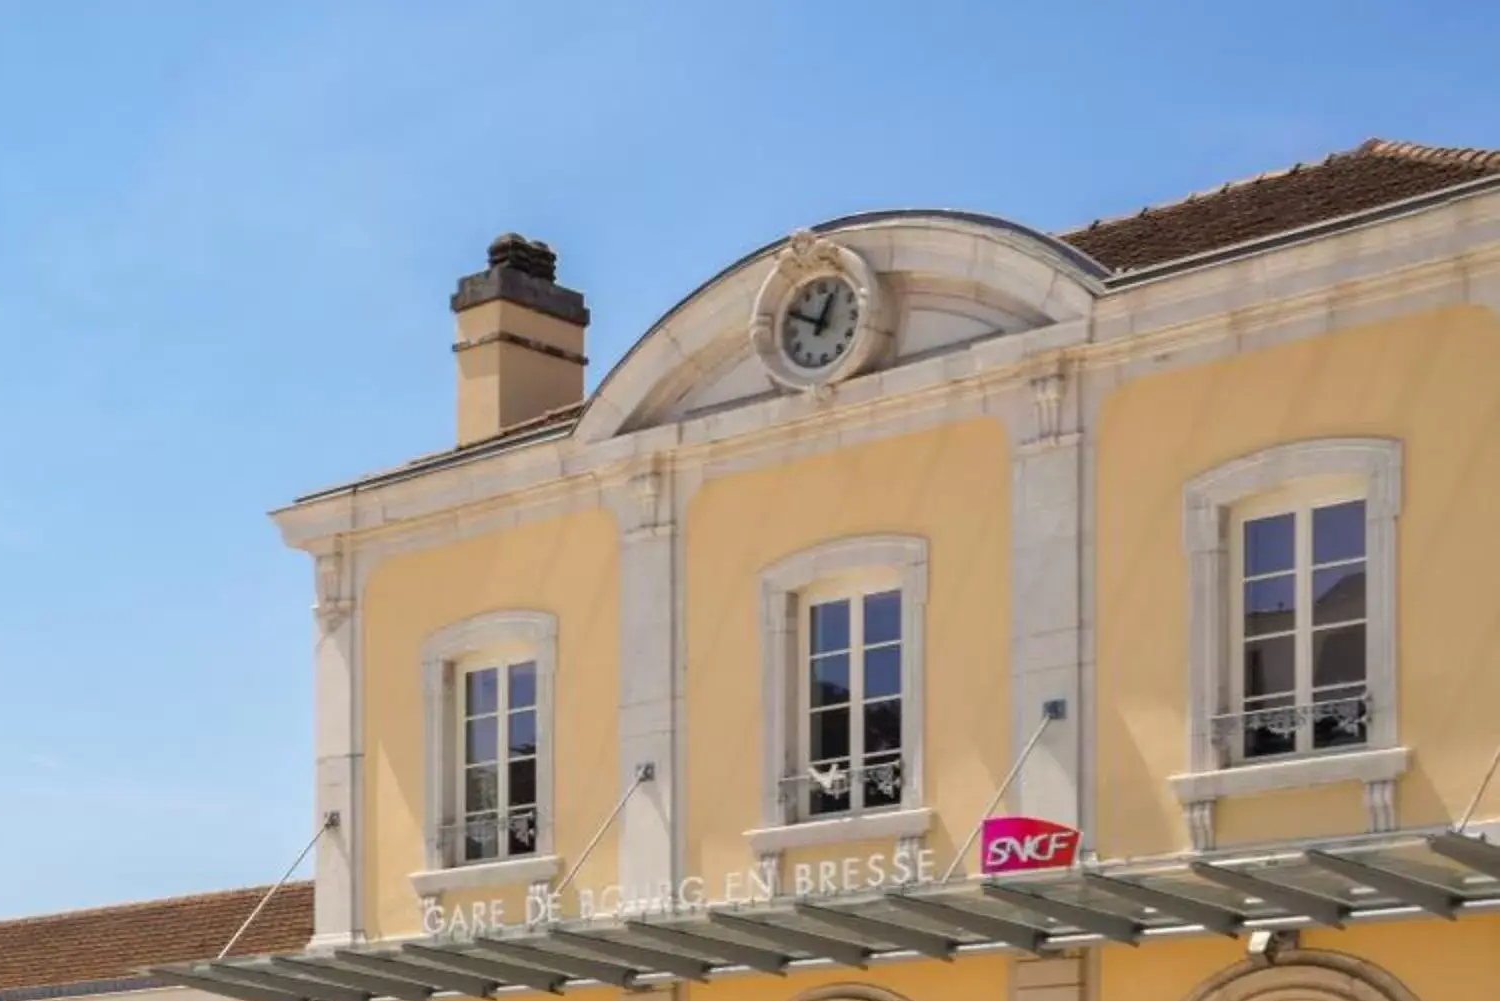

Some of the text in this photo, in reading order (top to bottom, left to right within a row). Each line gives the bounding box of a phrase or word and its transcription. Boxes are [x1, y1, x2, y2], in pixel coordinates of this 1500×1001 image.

[986, 832, 1075, 865] SNCF
[423, 899, 504, 936] GARE
[525, 894, 563, 925] DE
[725, 864, 775, 900] EN
[794, 850, 936, 897] BRESSE
